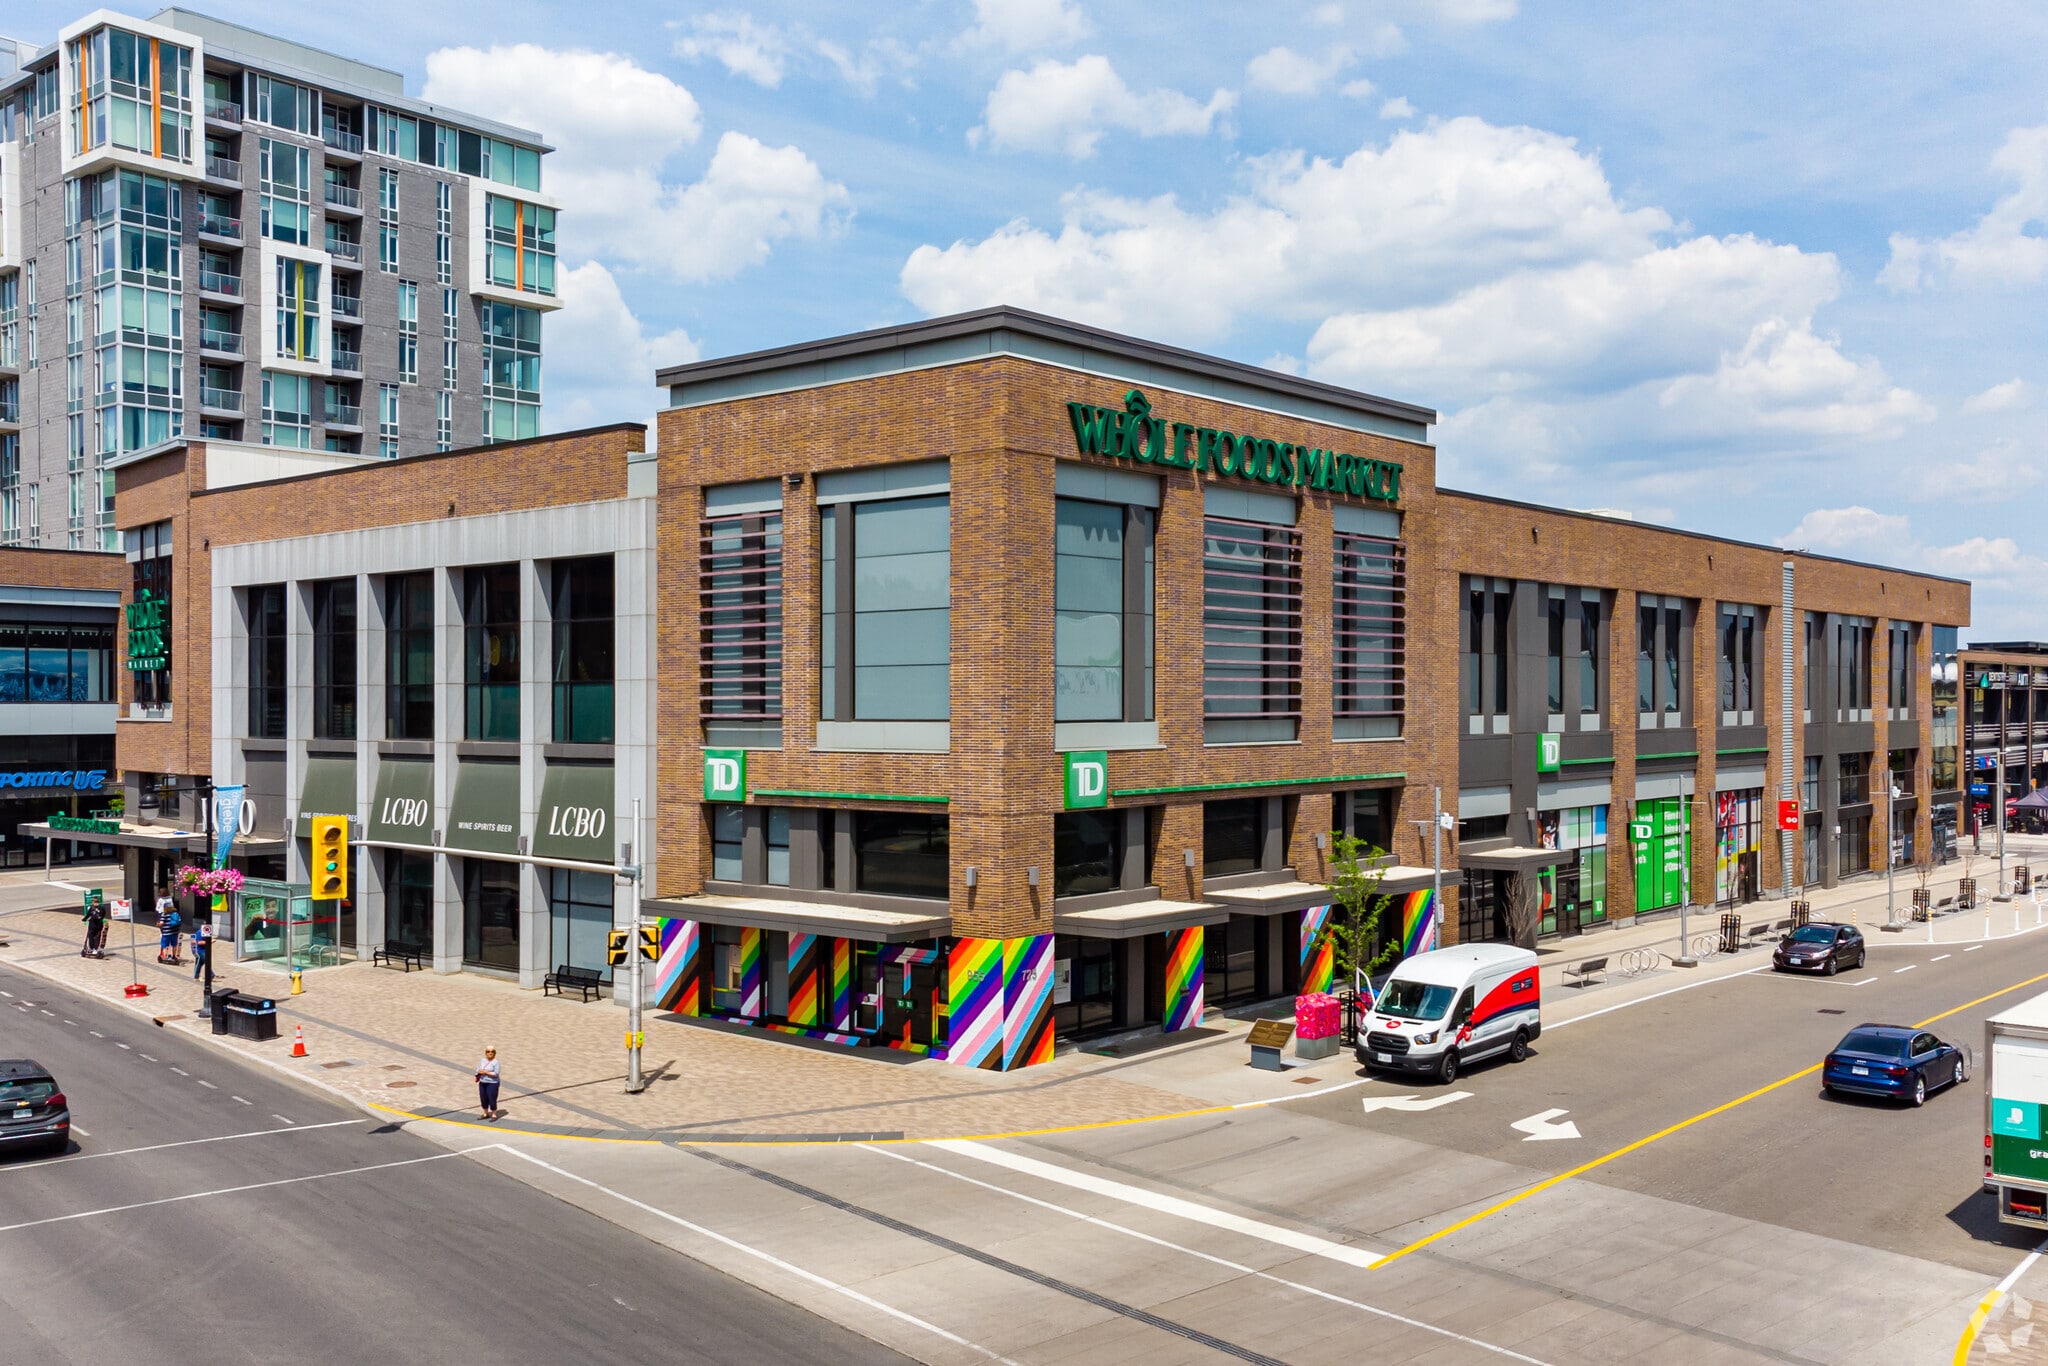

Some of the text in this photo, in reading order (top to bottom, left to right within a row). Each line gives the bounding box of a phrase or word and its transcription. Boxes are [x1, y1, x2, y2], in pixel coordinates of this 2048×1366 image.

[1065, 391, 1404, 501] WHOLE FOODS MARKET
[1542, 739, 1558, 765] TD
[706, 757, 740, 792] TD
[1072, 761, 1104, 797] TD
[220, 798, 235, 833] glebe
[381, 797, 428, 827] LCBO
[458, 821, 513, 833] WINE SPIRITS BEER
[549, 805, 606, 839] LCBO
[1632, 824, 1653, 839] TD
